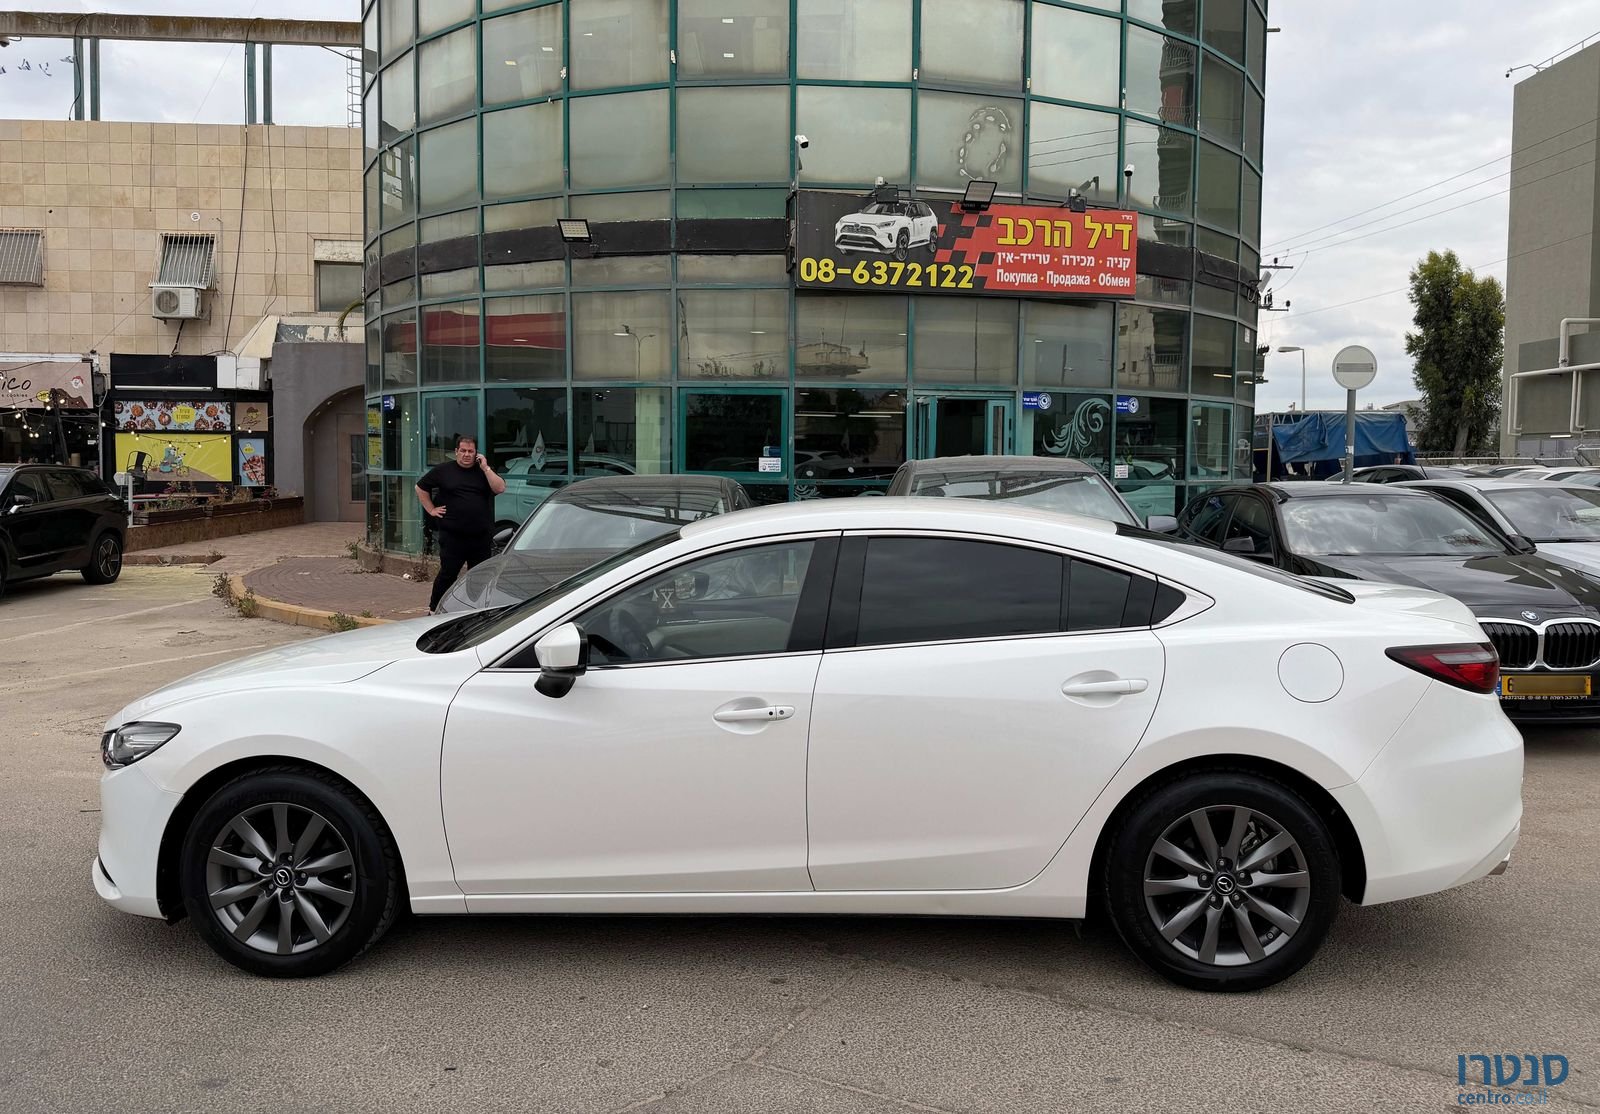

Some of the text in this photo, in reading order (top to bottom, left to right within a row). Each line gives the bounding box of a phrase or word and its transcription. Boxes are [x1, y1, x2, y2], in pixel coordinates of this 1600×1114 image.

[997, 215, 1133, 251] דיל הרכב
[800, 257, 973, 289] 08-6372122
[996, 251, 1131, 271] קניה מכירה טרייד-אין
[996, 269, 1131, 288] Покупка Продажа Обмен
